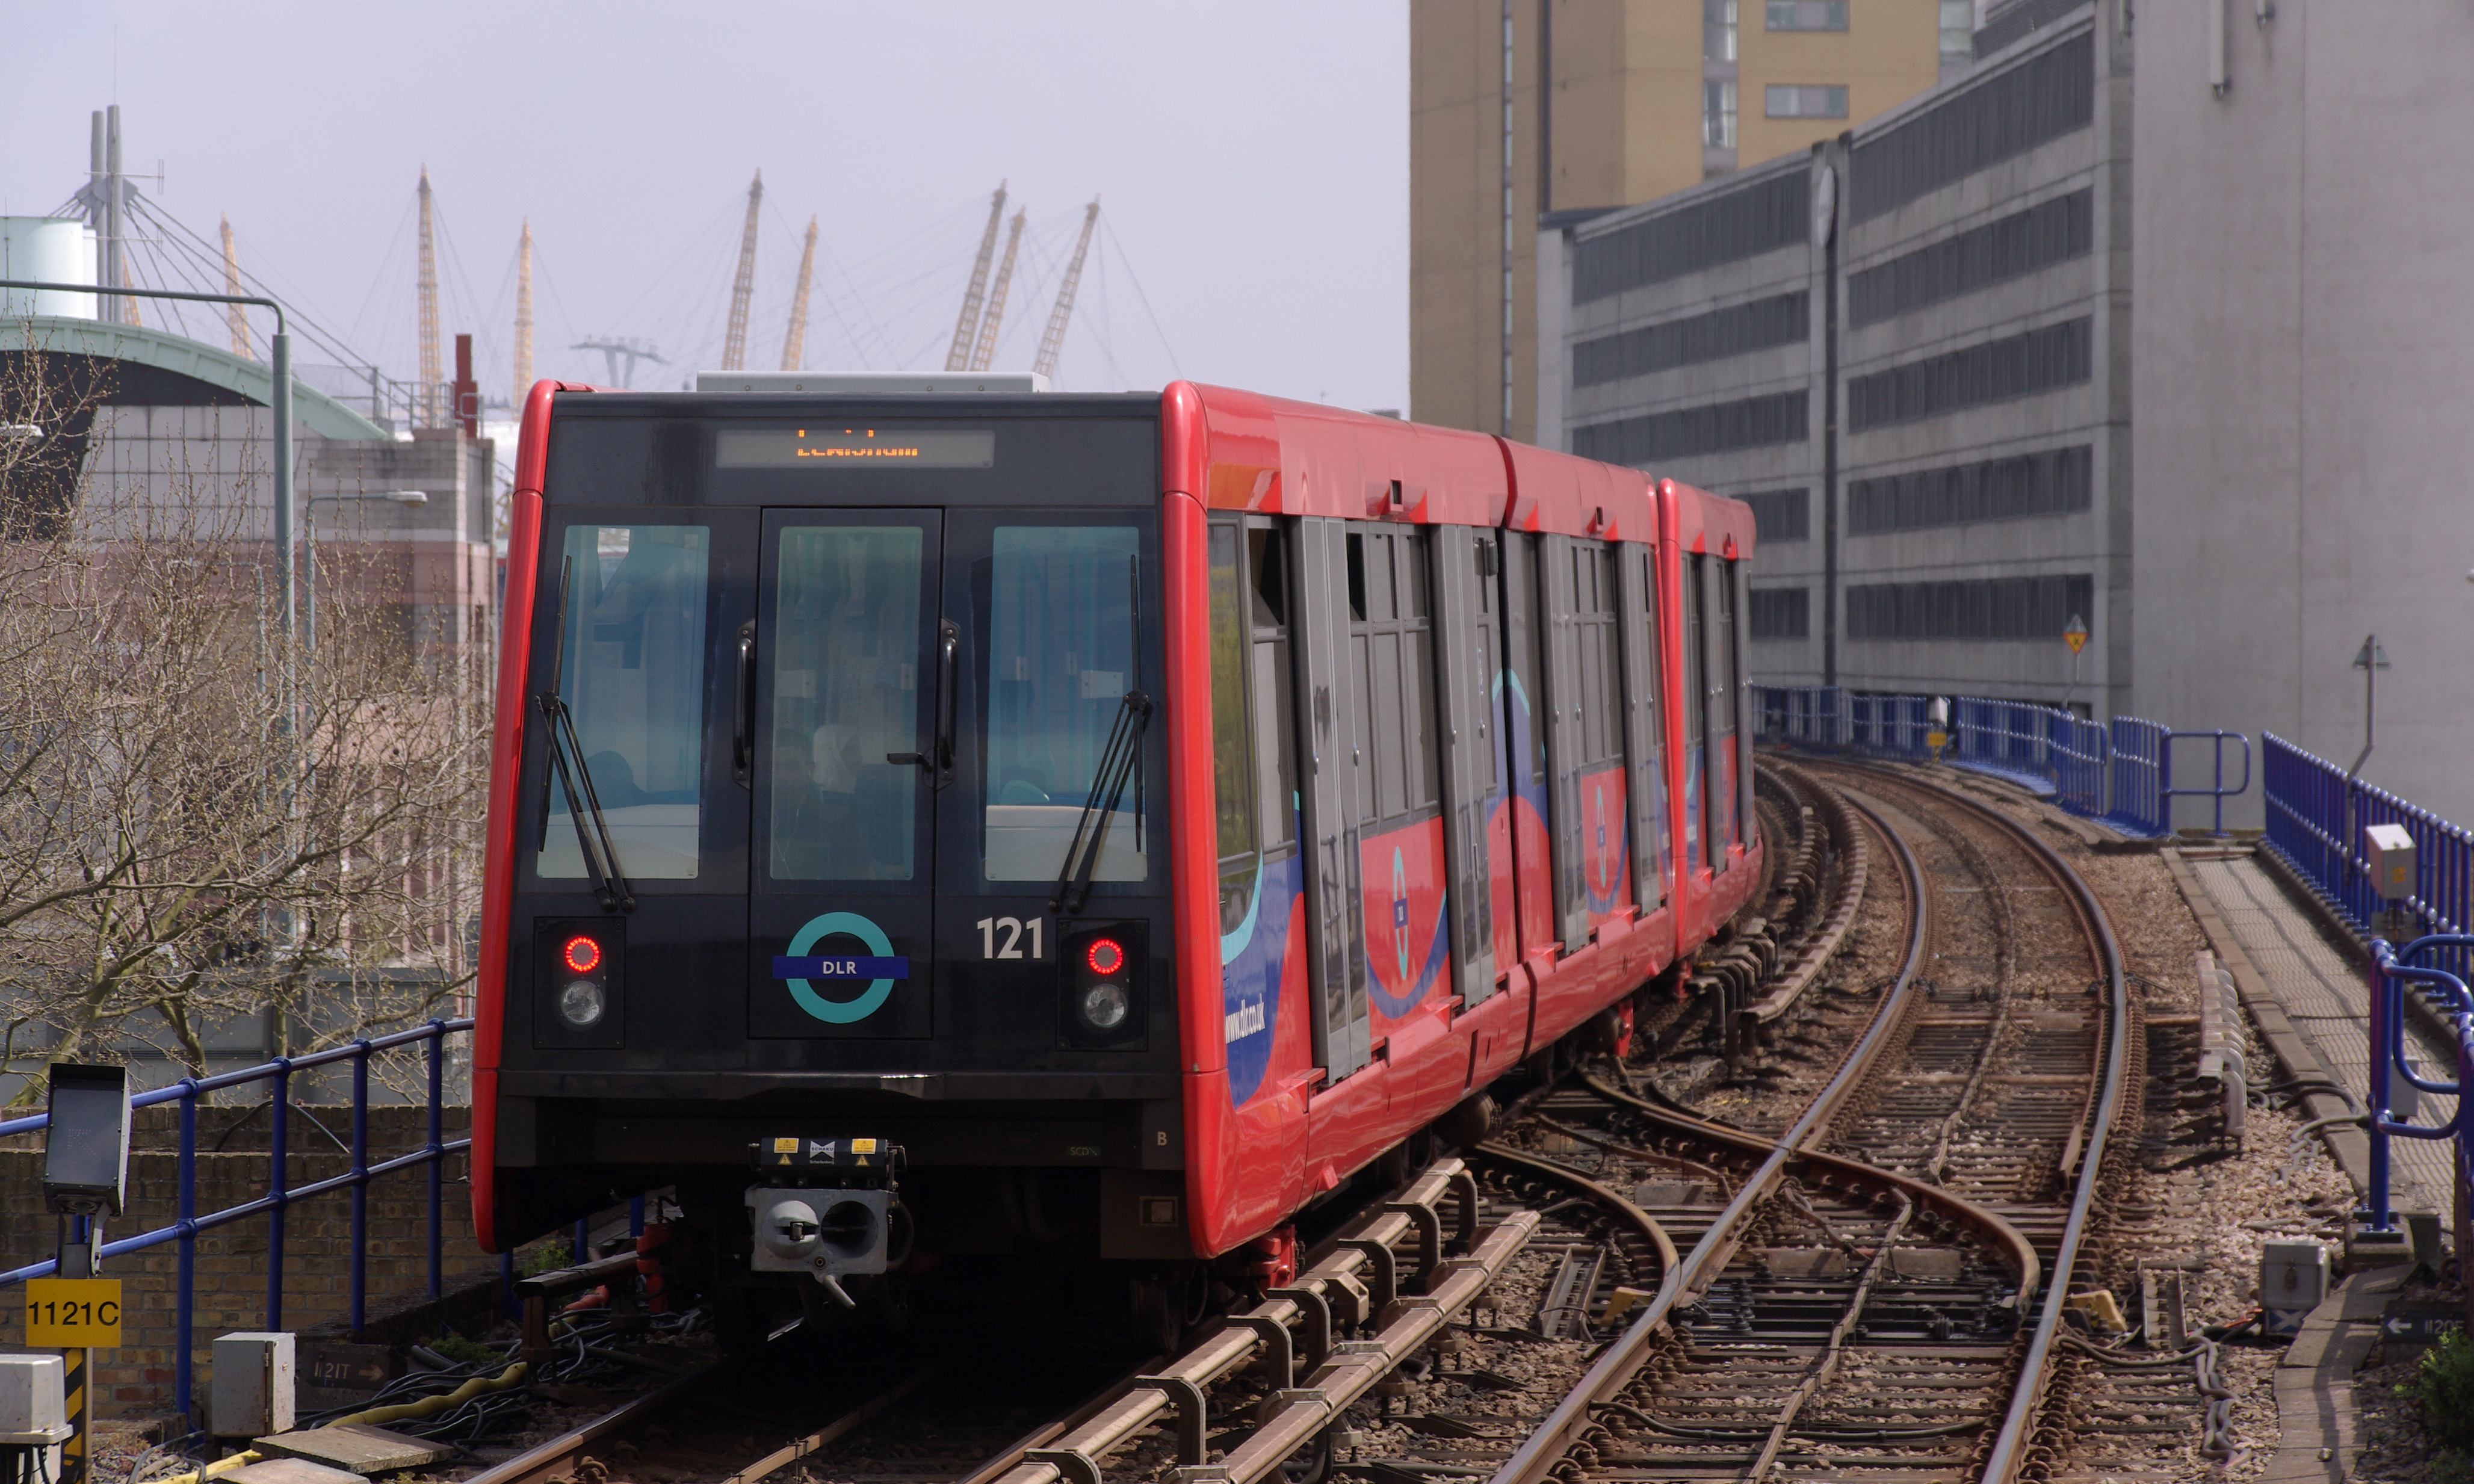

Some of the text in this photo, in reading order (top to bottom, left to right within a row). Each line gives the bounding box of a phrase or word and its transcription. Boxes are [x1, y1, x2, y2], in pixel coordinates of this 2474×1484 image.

[977, 917, 1042, 959] 121
[823, 961, 857, 974] DLR
[1225, 992, 1266, 1044] www.dlr.co.uk
[1157, 1131, 1167, 1146] B
[28, 1301, 119, 1326] 1121C
